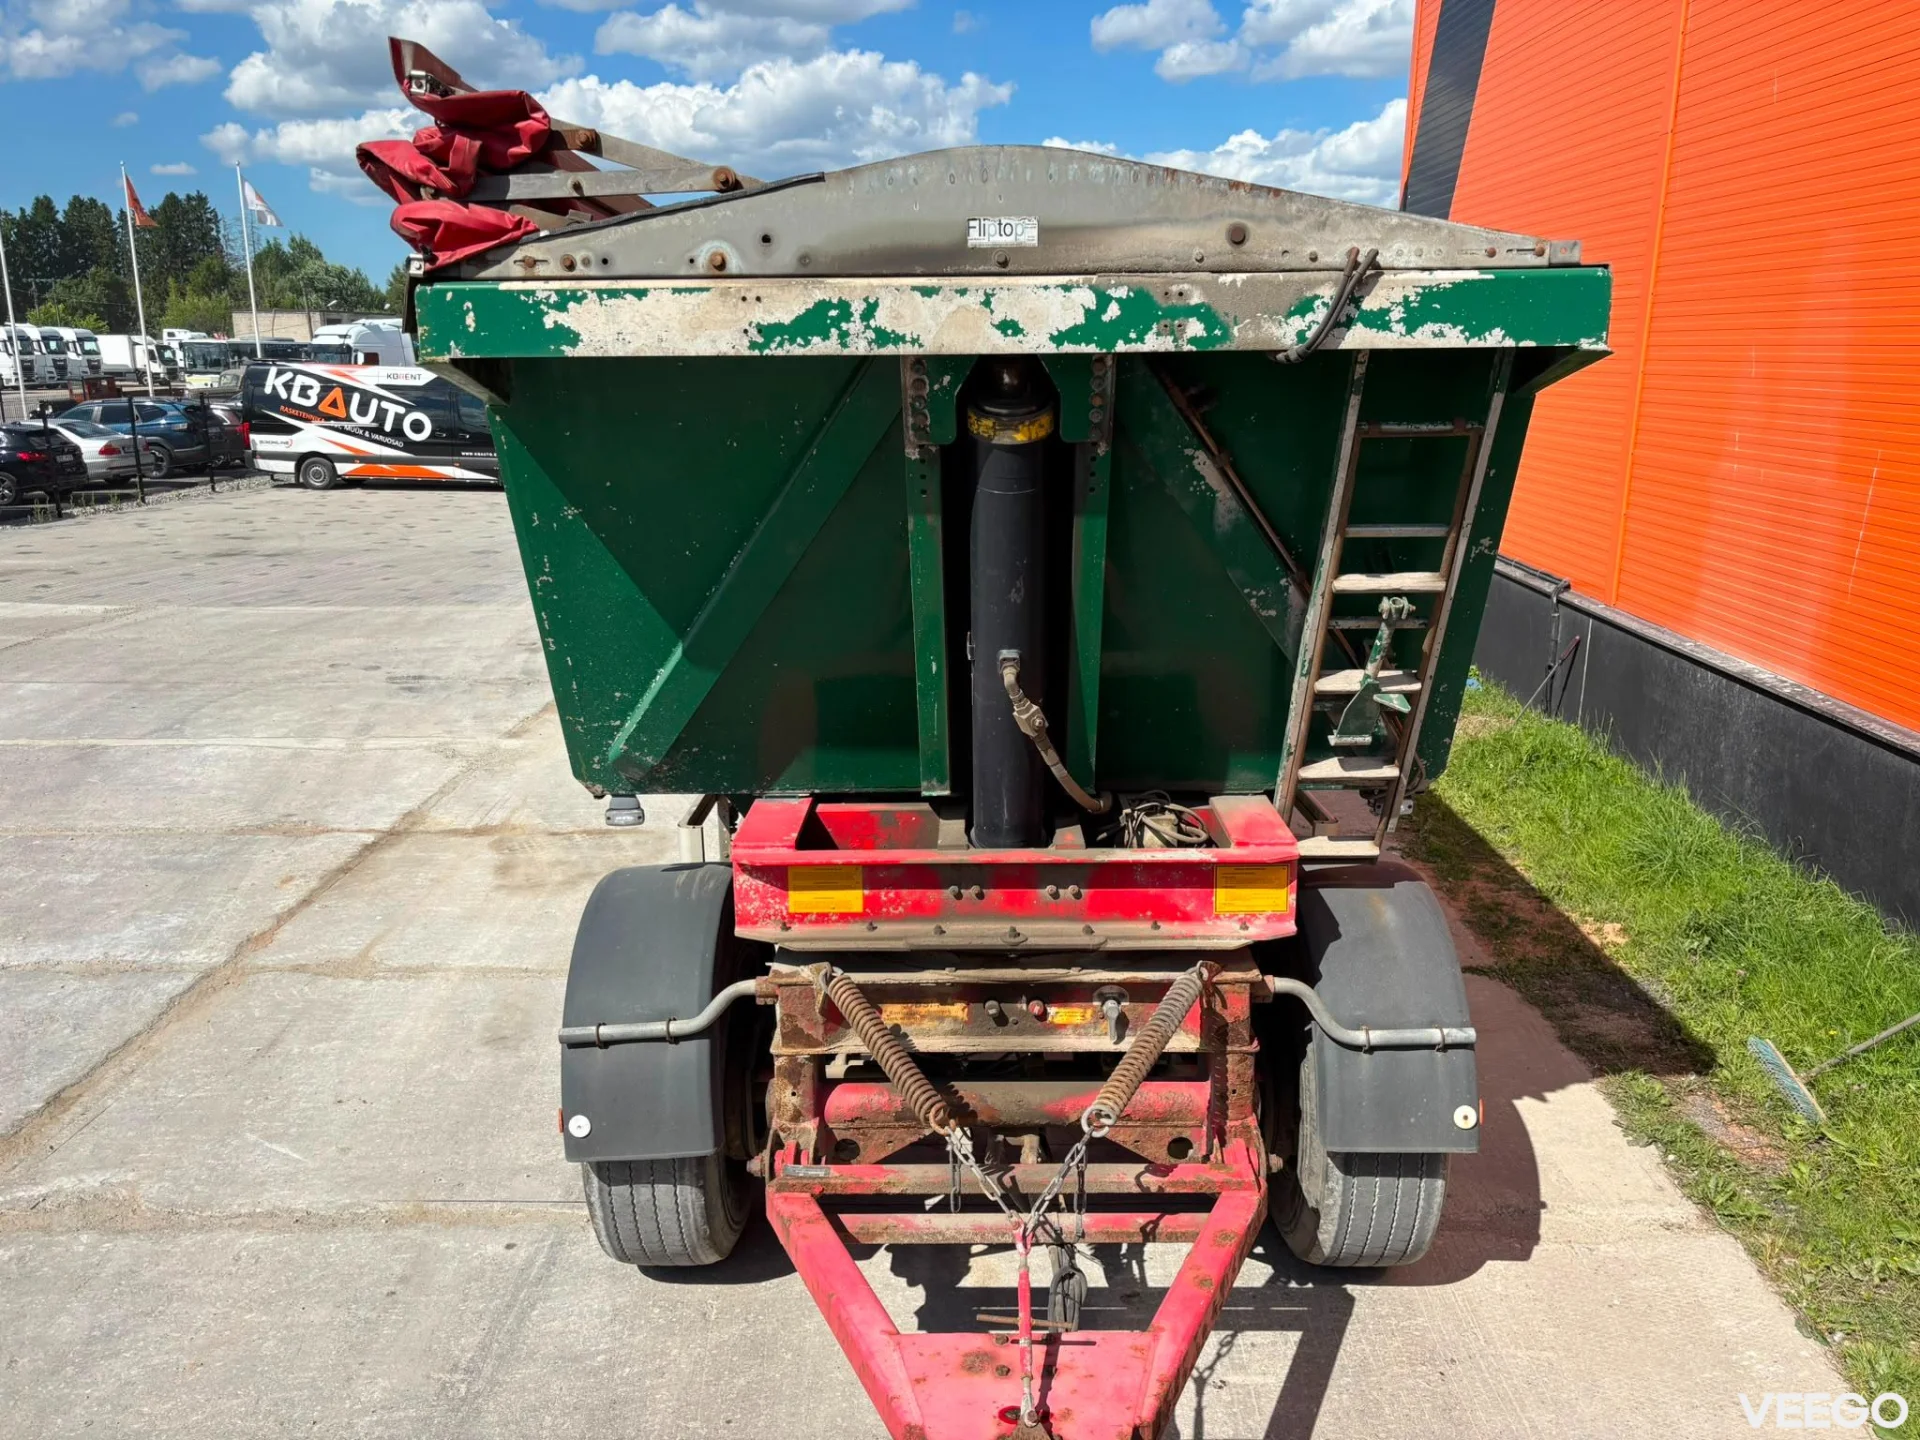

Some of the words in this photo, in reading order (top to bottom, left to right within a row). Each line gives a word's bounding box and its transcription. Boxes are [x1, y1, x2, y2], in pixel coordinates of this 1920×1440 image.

[967, 218, 1025, 242] Fliptop
[264, 366, 432, 442] KBAUTO
[371, 432, 404, 448] VARUOSAD
